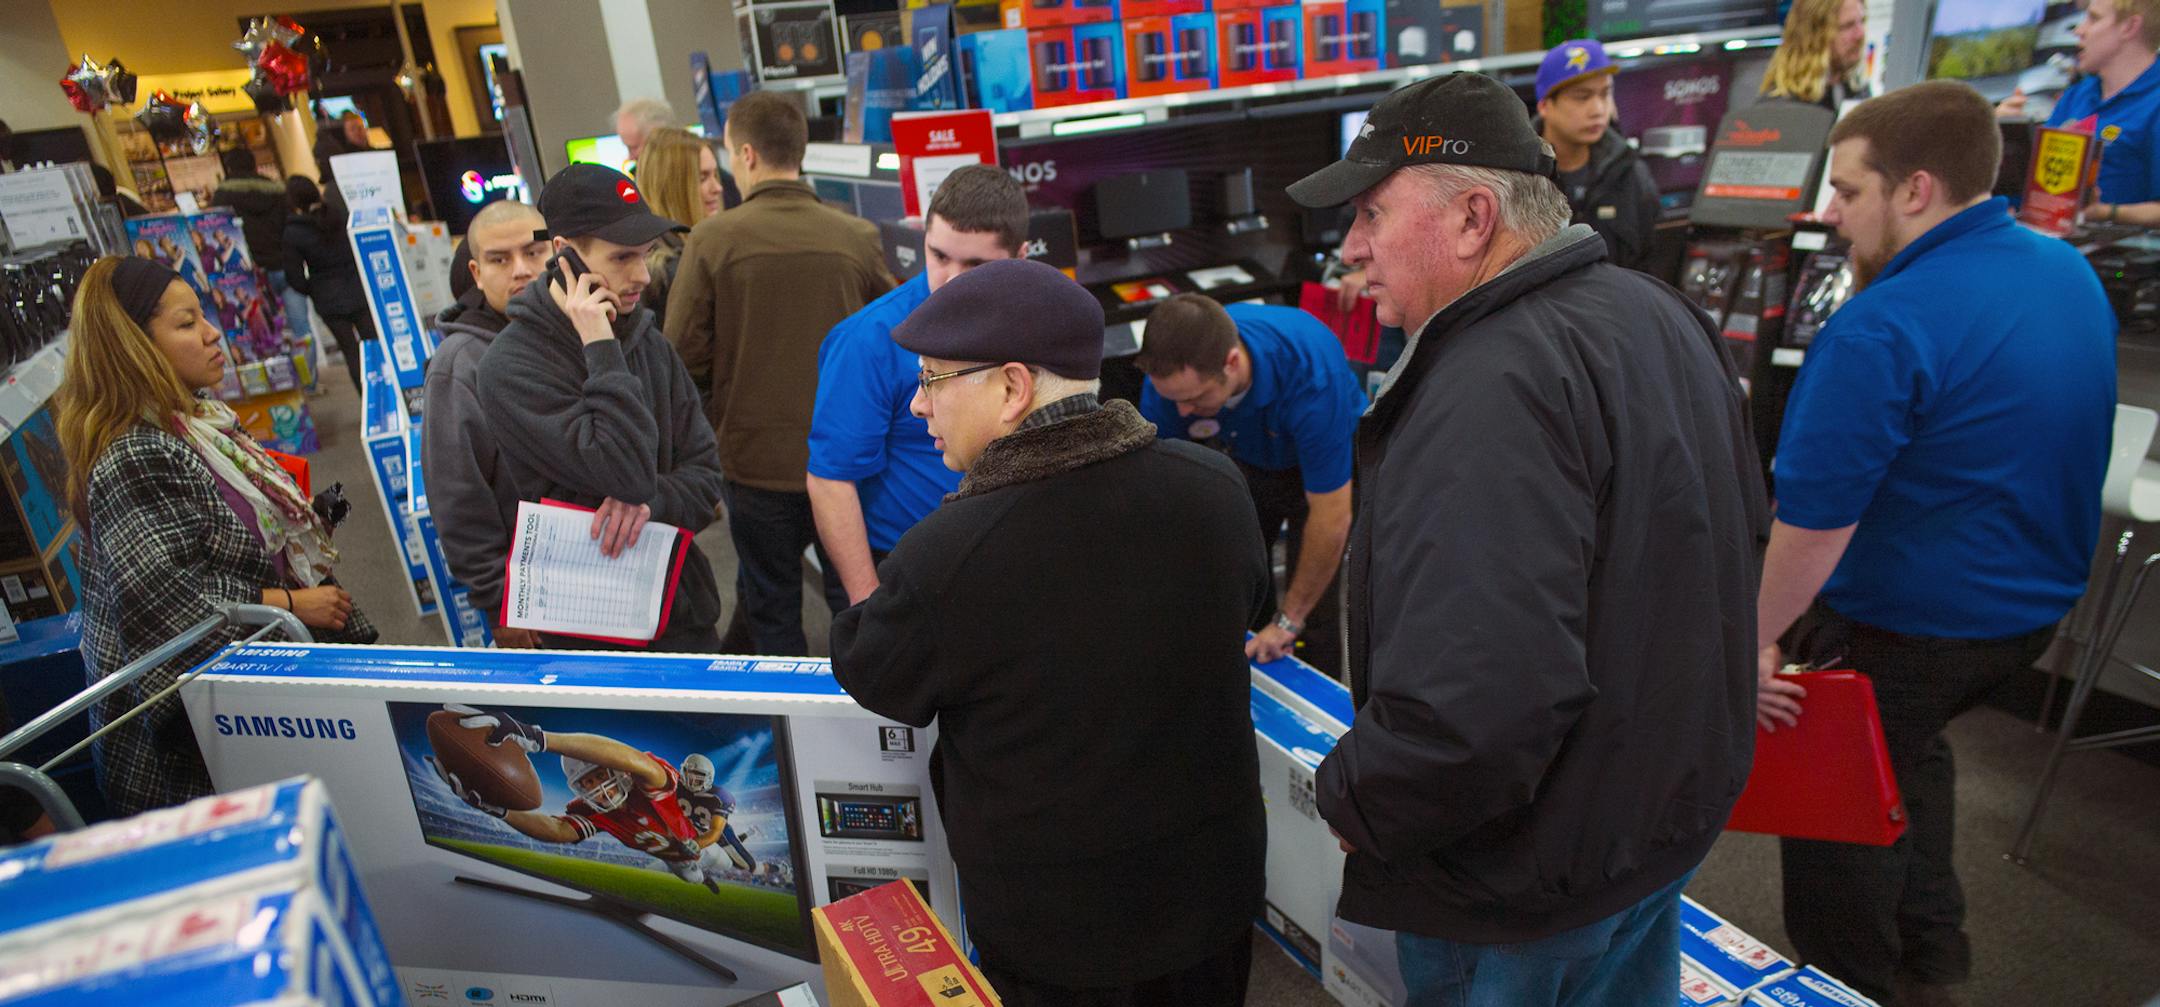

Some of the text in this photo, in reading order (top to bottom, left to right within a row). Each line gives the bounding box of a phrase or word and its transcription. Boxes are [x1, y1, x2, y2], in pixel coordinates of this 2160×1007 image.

[1664, 74, 1721, 99] SONOS
[928, 129, 956, 142] SALE
[1009, 160, 1057, 183] NOS
[517, 513, 535, 618] MONTHLY PAYMENTS TOOL
[215, 714, 356, 740] SAMSUNG
[888, 729, 896, 740] 6
[848, 782, 884, 792] Smart Hub
[853, 866, 898, 877] Full HD 1080p
[853, 915, 908, 982] ULTRA HDTV
